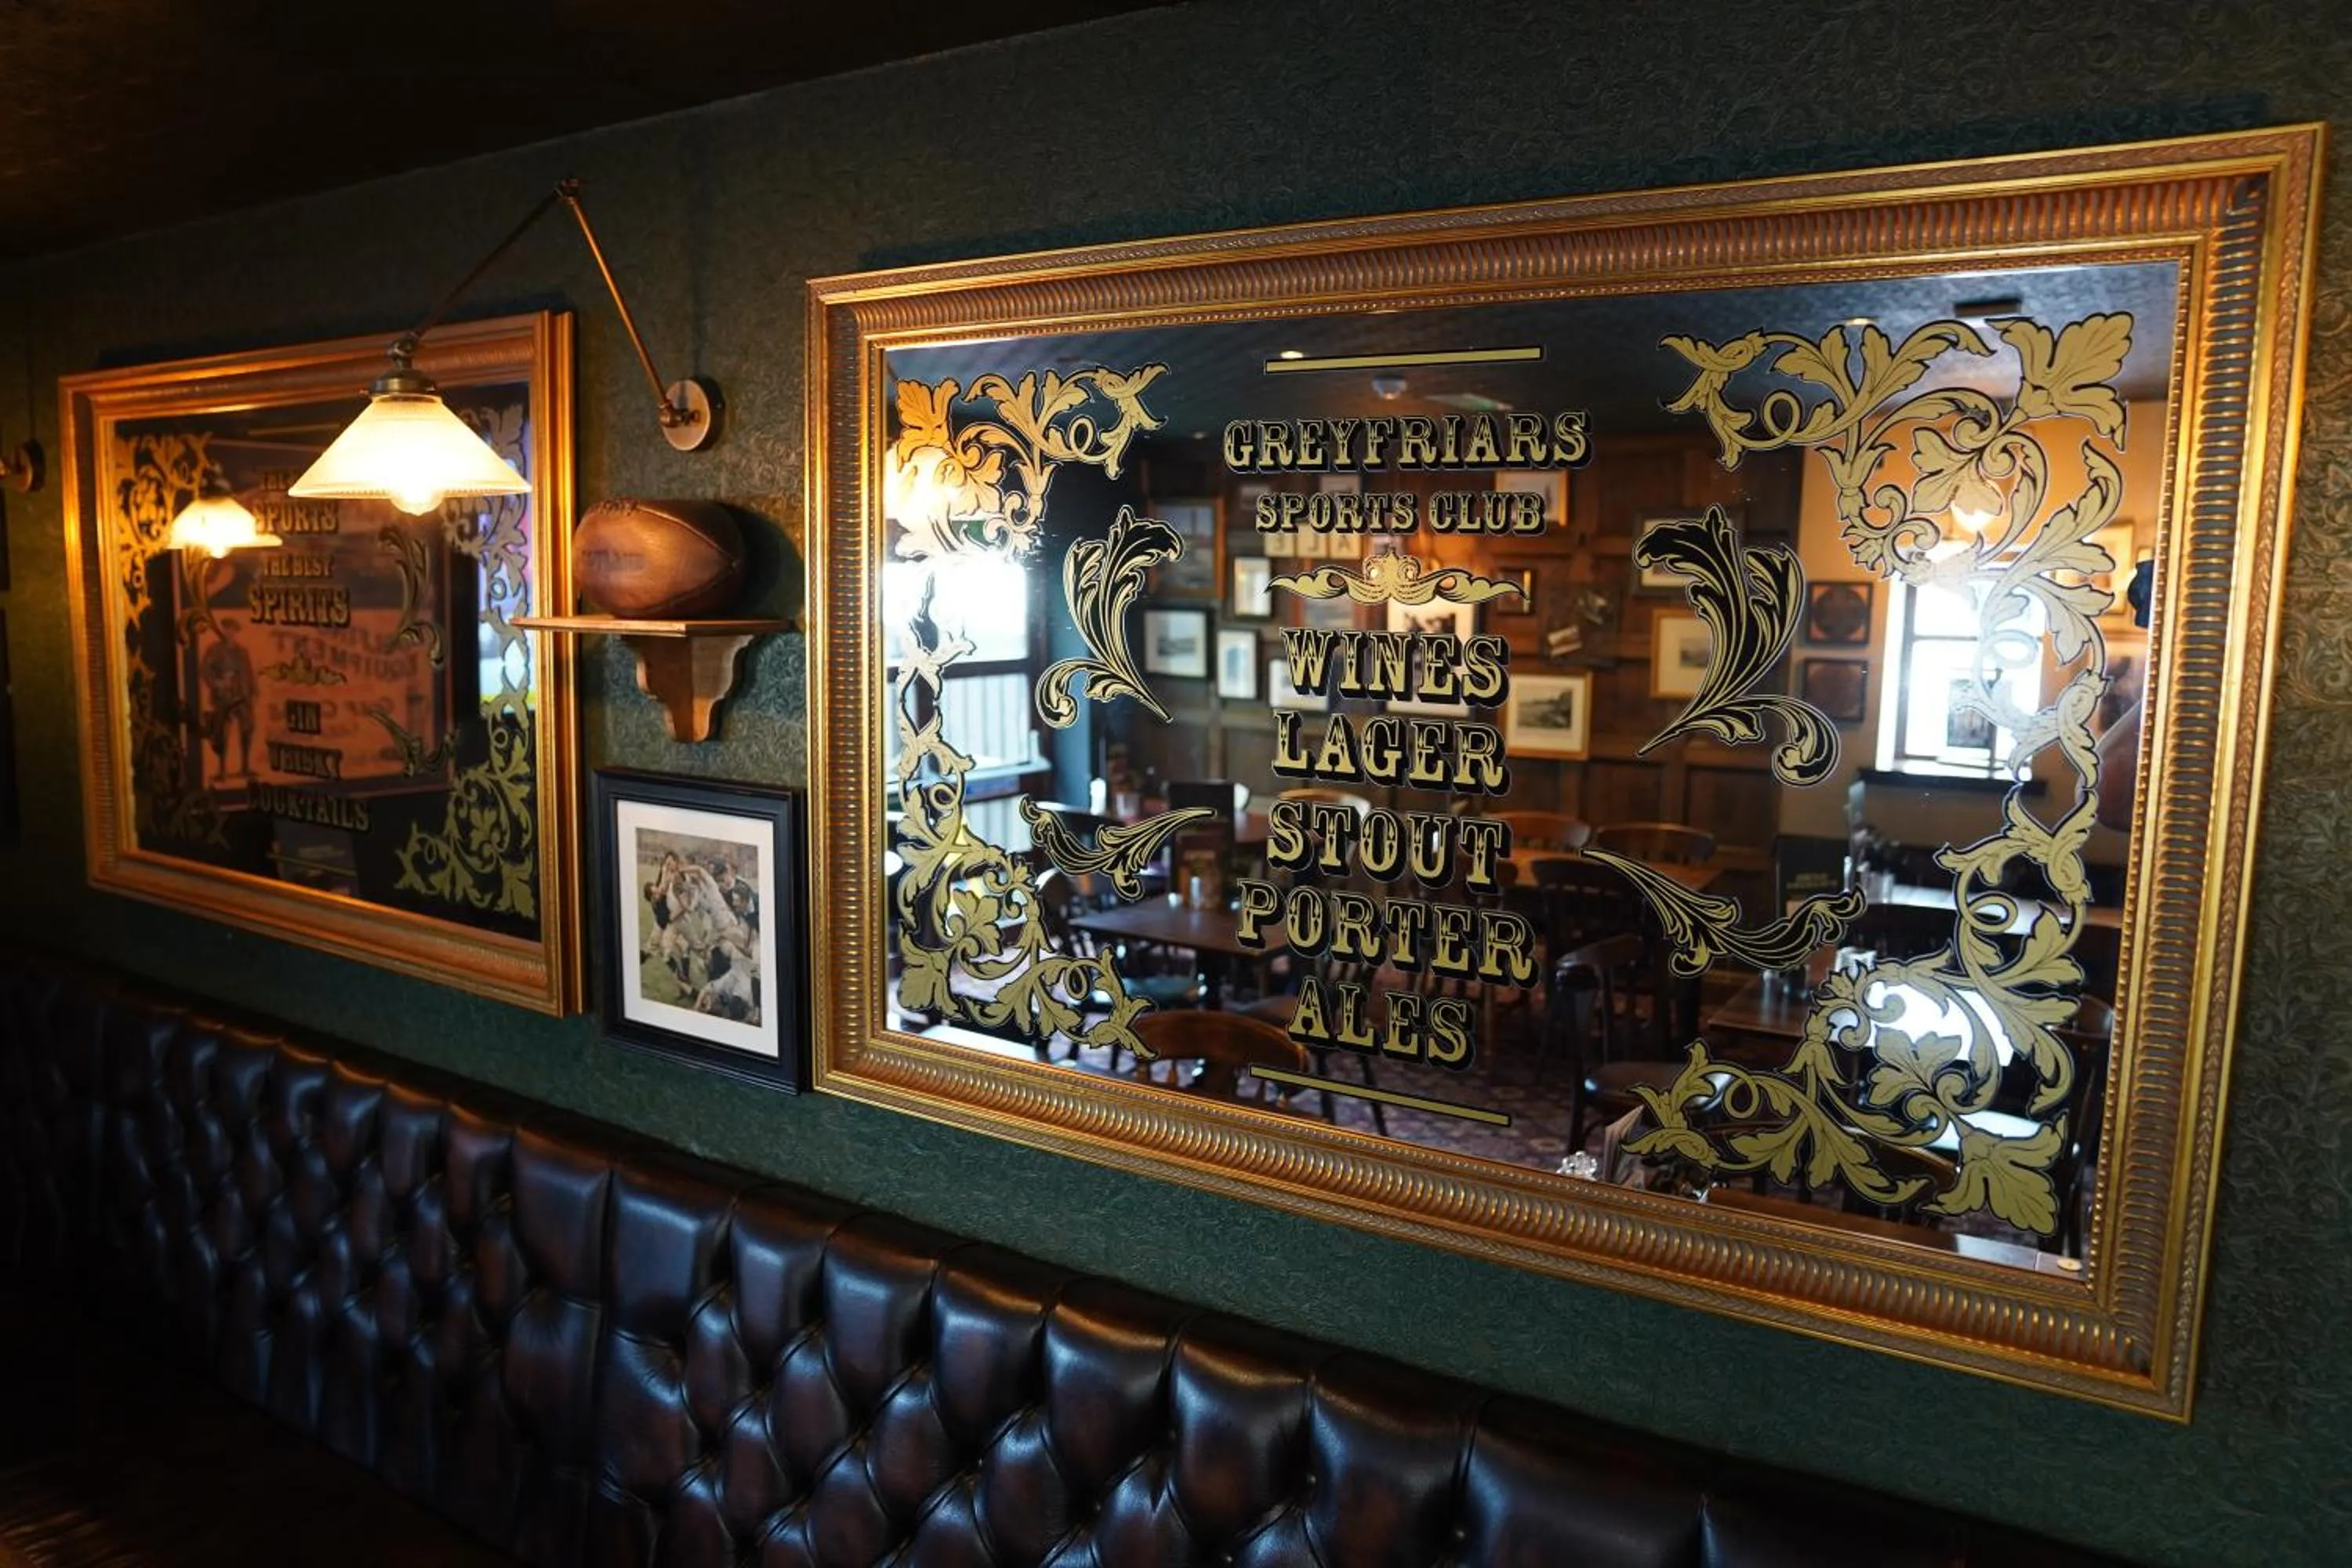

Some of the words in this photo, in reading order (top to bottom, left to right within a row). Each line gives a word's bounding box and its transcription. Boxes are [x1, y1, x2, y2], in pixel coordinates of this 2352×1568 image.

[1223, 409, 1593, 474] GREYFRIARS
[252, 498, 340, 534] SPORTS
[1254, 490, 1420, 535] SPORTS
[1428, 490, 1548, 537] CLUB
[261, 551, 290, 577] THE
[291, 552, 336, 579] BEST
[249, 583, 351, 627] SPIRITS
[1279, 626, 1511, 710] WINES
[285, 699, 321, 735] GIN
[267, 739, 344, 780] WHISKY
[1272, 708, 1512, 797] LAGER
[1266, 800, 1514, 895] STOUT
[1235, 877, 1541, 990] PORTER
[1287, 975, 1475, 1072] ALES
